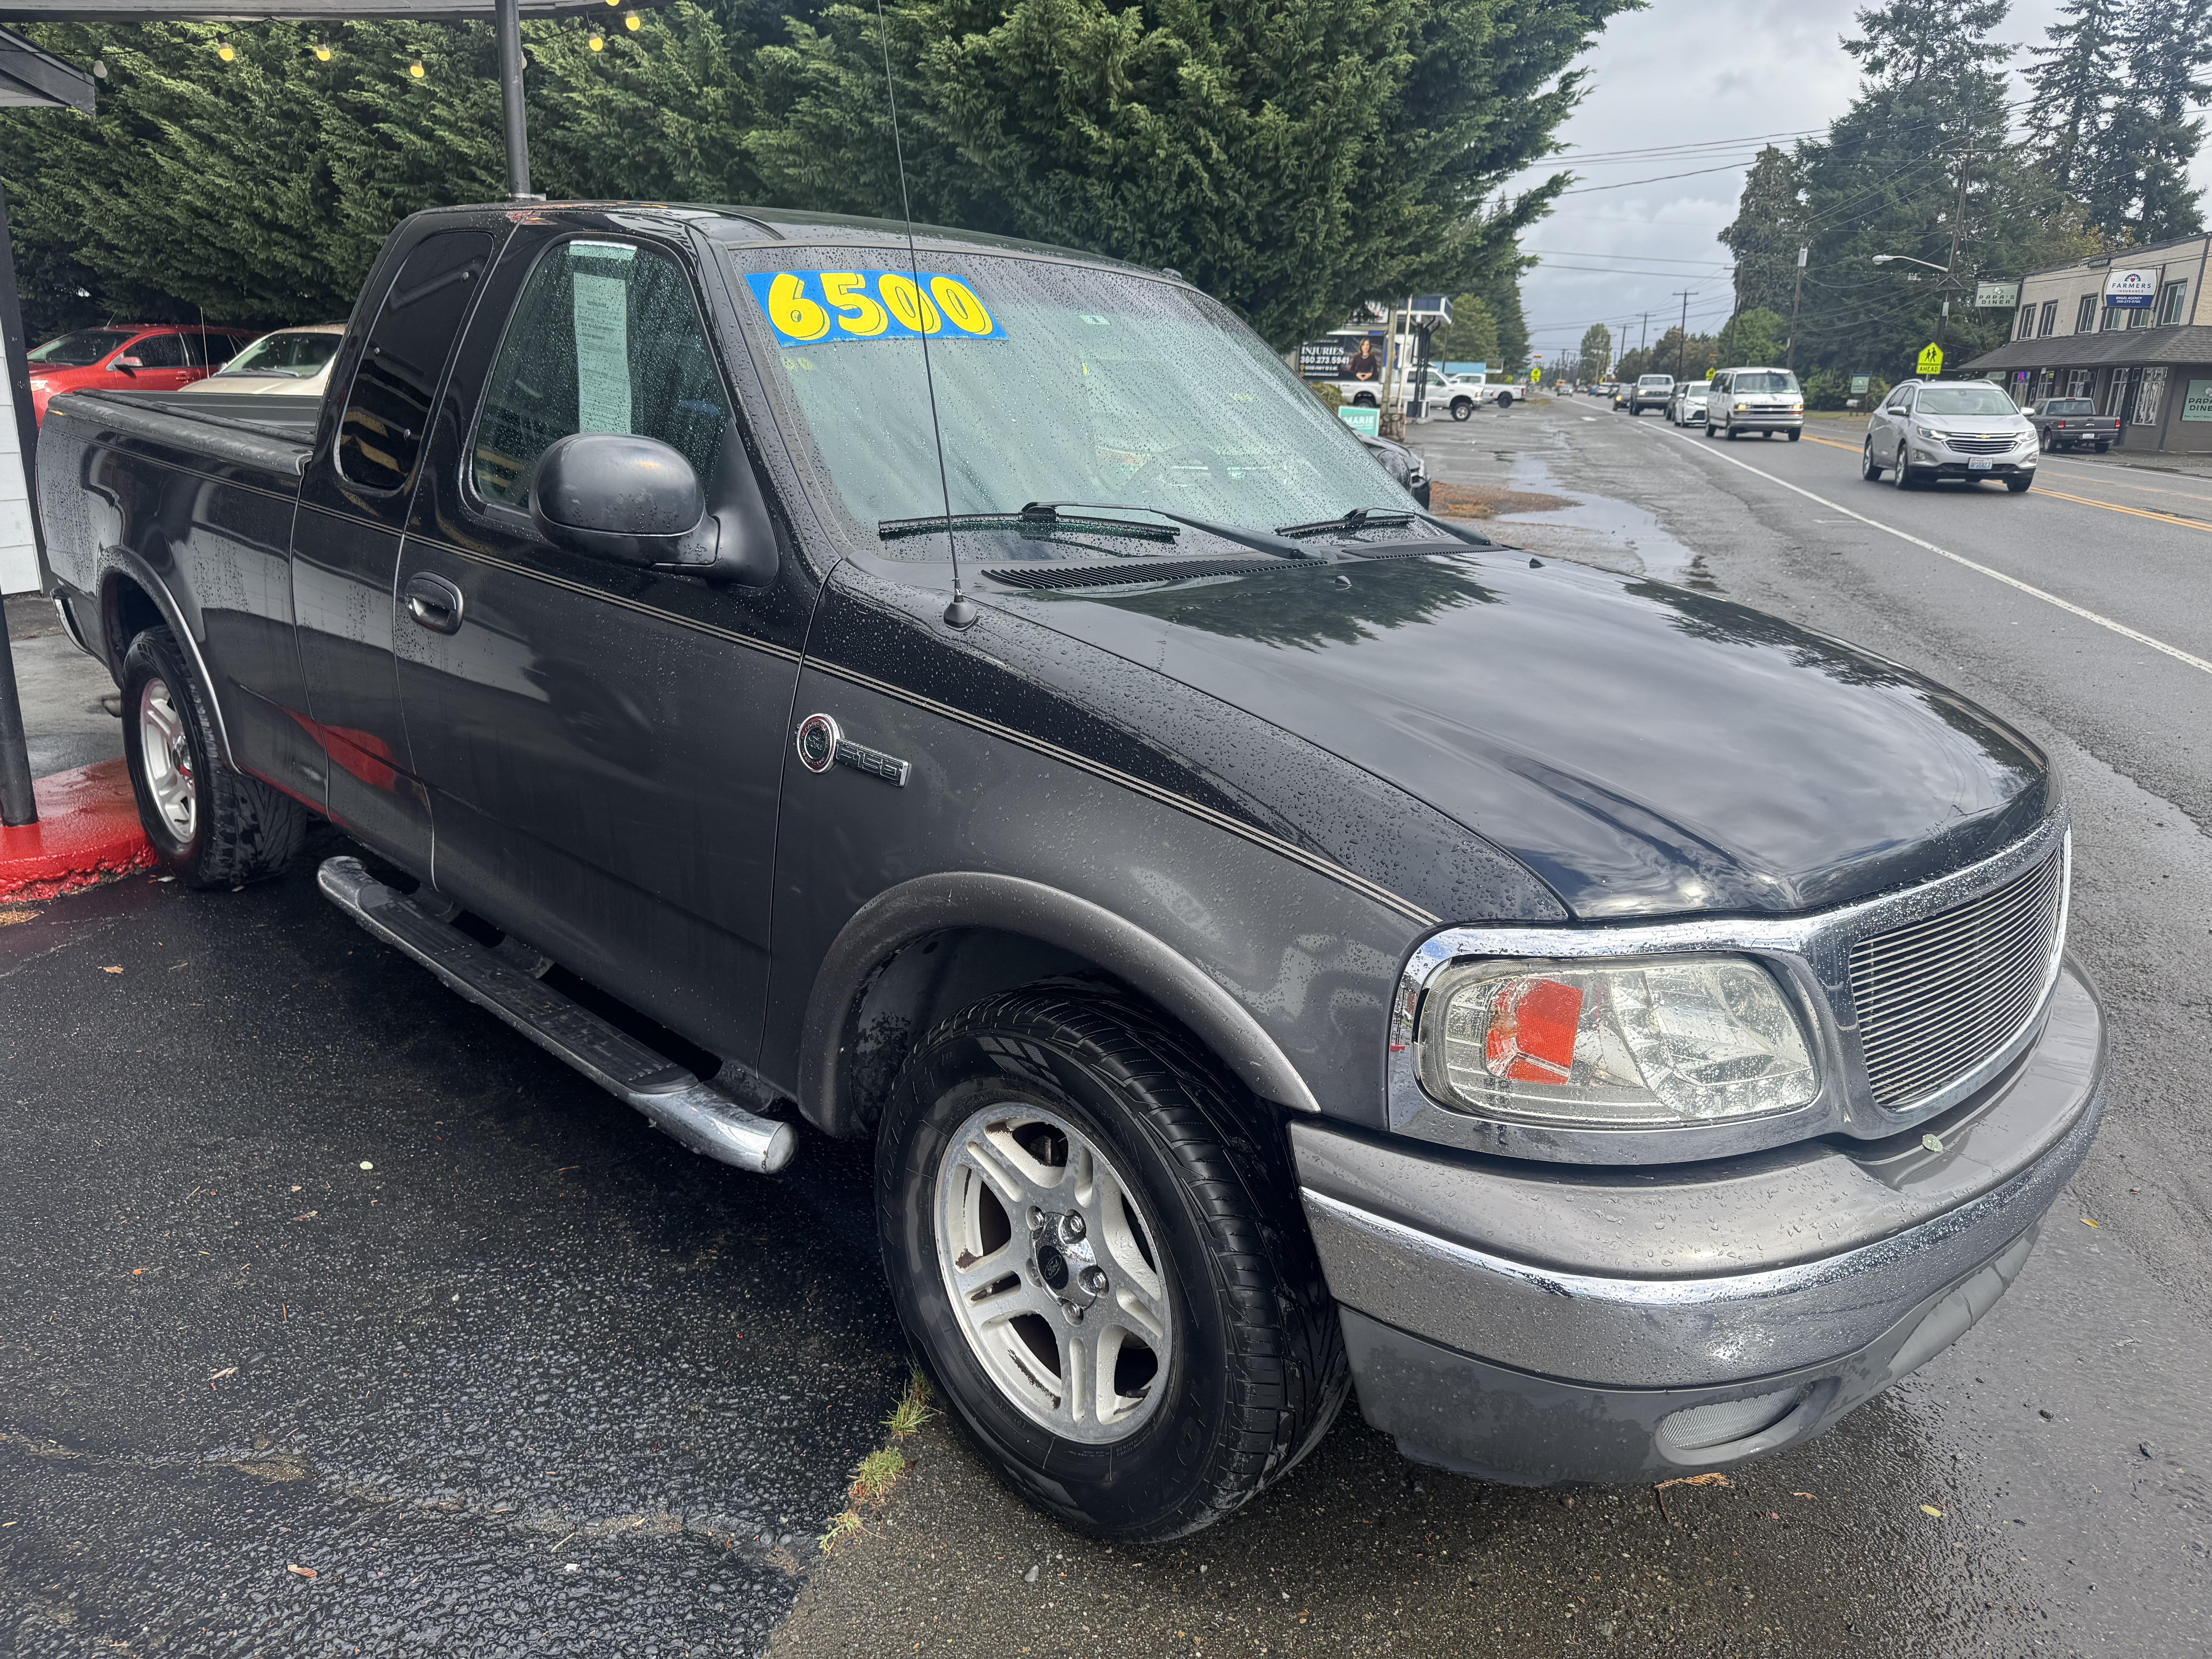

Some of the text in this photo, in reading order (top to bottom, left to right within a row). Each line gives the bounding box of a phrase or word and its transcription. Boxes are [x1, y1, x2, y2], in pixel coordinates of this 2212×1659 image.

[768, 273, 993, 341] 6500
[1301, 346, 1344, 356] INJURIES
[1300, 356, 1350, 364] 360.273.5941
[836, 744, 900, 781] F-150
[1047, 1259, 1059, 1276] Ford
